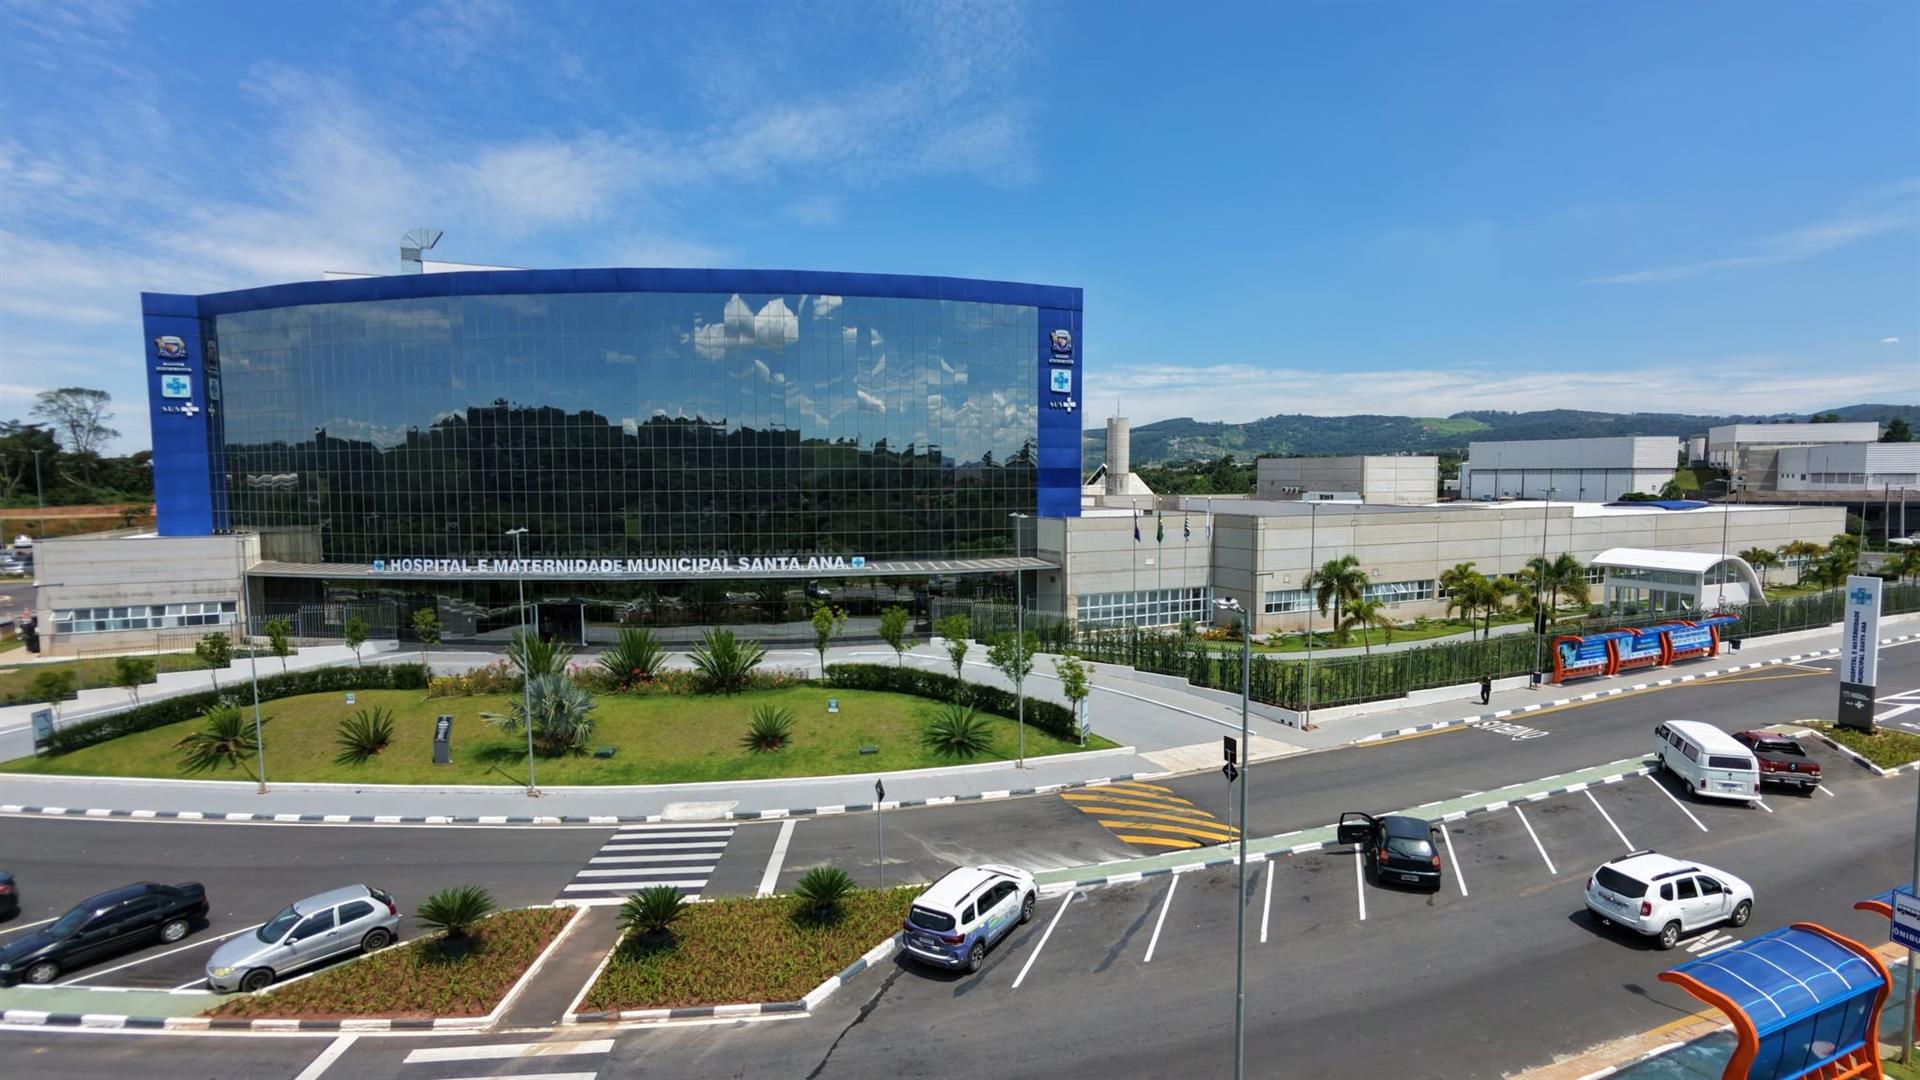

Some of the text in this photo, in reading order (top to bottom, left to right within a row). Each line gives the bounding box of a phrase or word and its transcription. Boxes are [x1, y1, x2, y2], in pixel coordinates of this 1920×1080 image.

[390, 556, 845, 573] HOSPITAL E MATERNIDADE MUNICIPAL SANTA ANA
